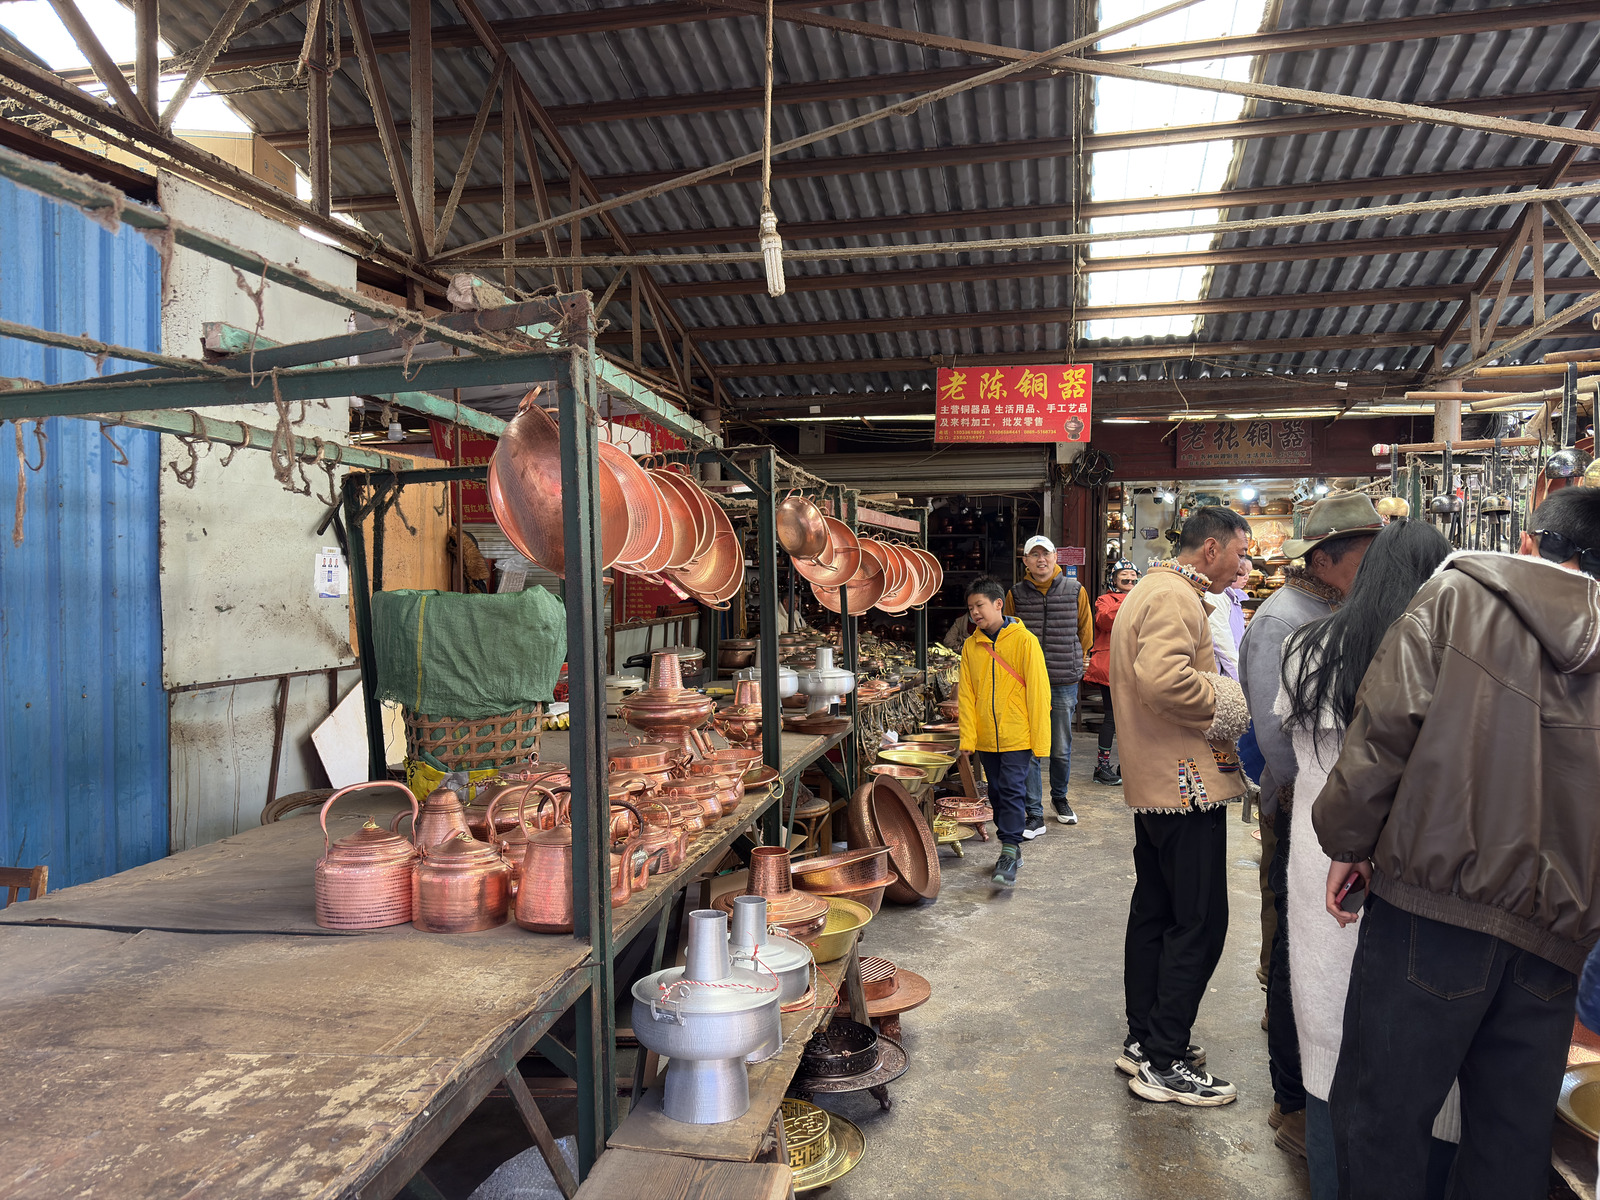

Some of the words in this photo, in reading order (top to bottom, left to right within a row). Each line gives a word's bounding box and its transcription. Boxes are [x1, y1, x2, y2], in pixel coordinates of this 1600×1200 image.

[940, 368, 1087, 401] 老陈铜器
[940, 404, 991, 415] 主营铜器品
[1181, 421, 1305, 451] 老张铜器
